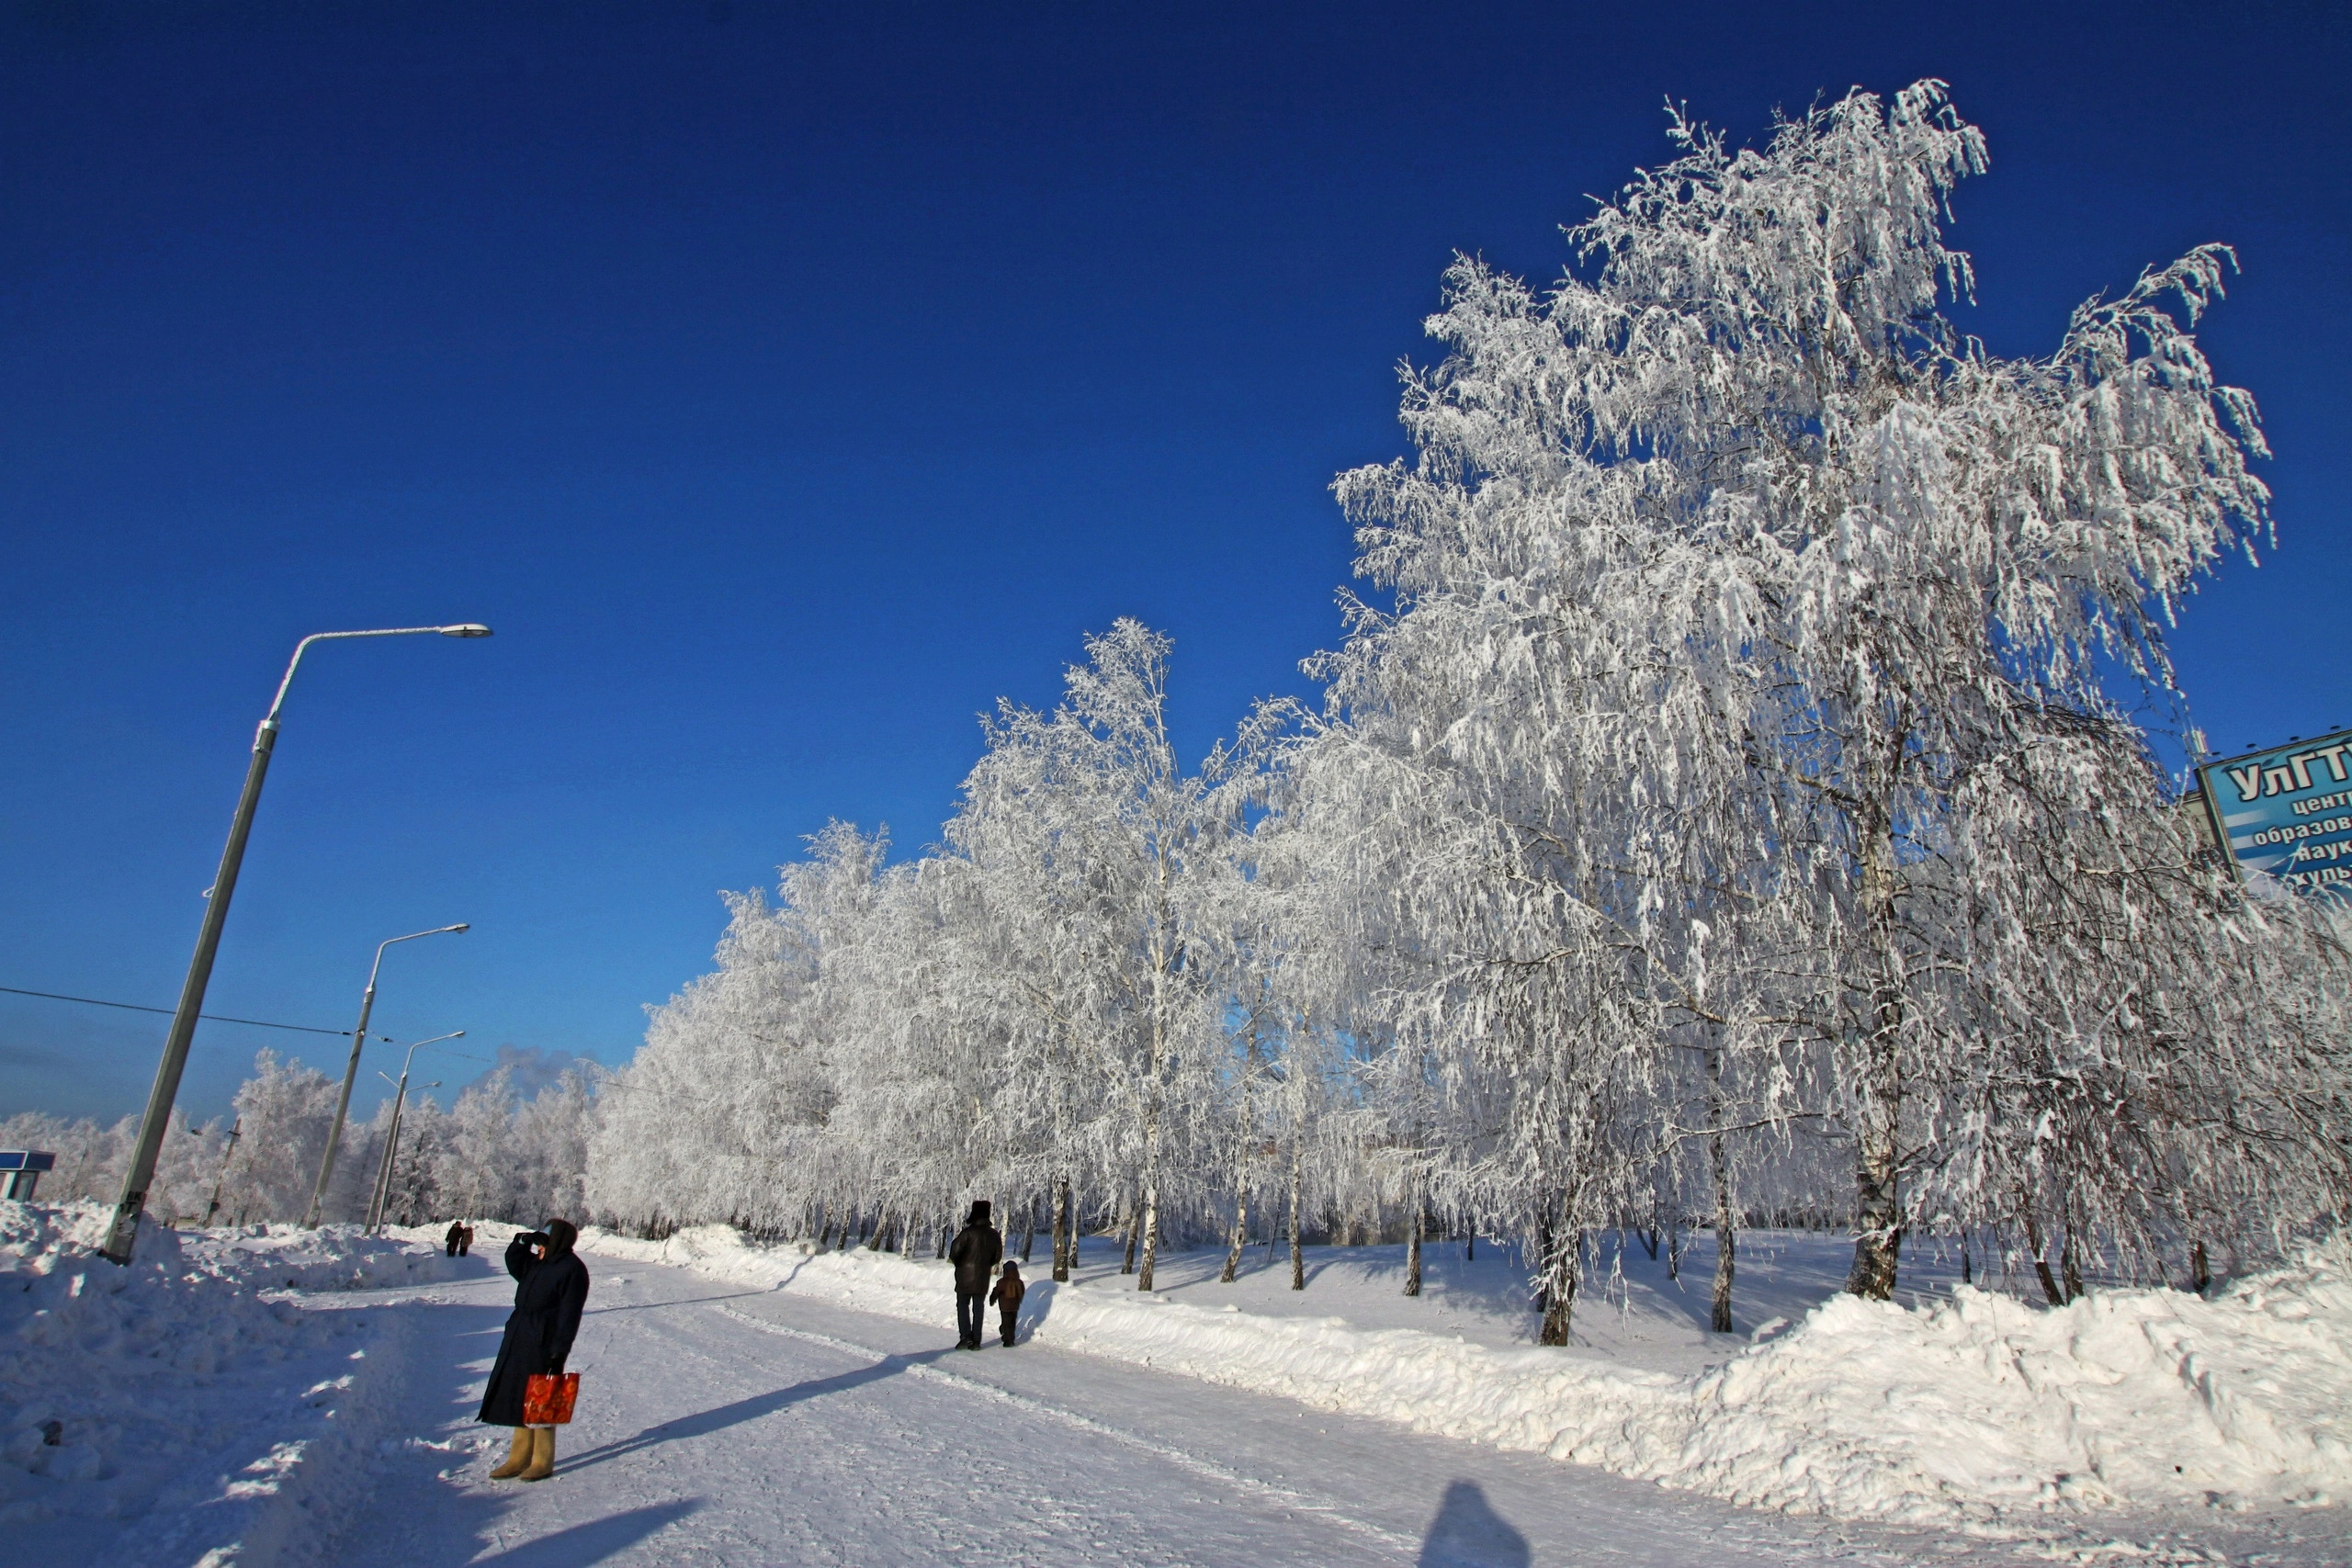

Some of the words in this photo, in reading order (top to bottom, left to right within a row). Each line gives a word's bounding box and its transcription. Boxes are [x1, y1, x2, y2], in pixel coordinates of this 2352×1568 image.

[2227, 742, 2352, 802] УлГТ
[2254, 816, 2352, 845] образов
[2292, 863, 2352, 887] куль
